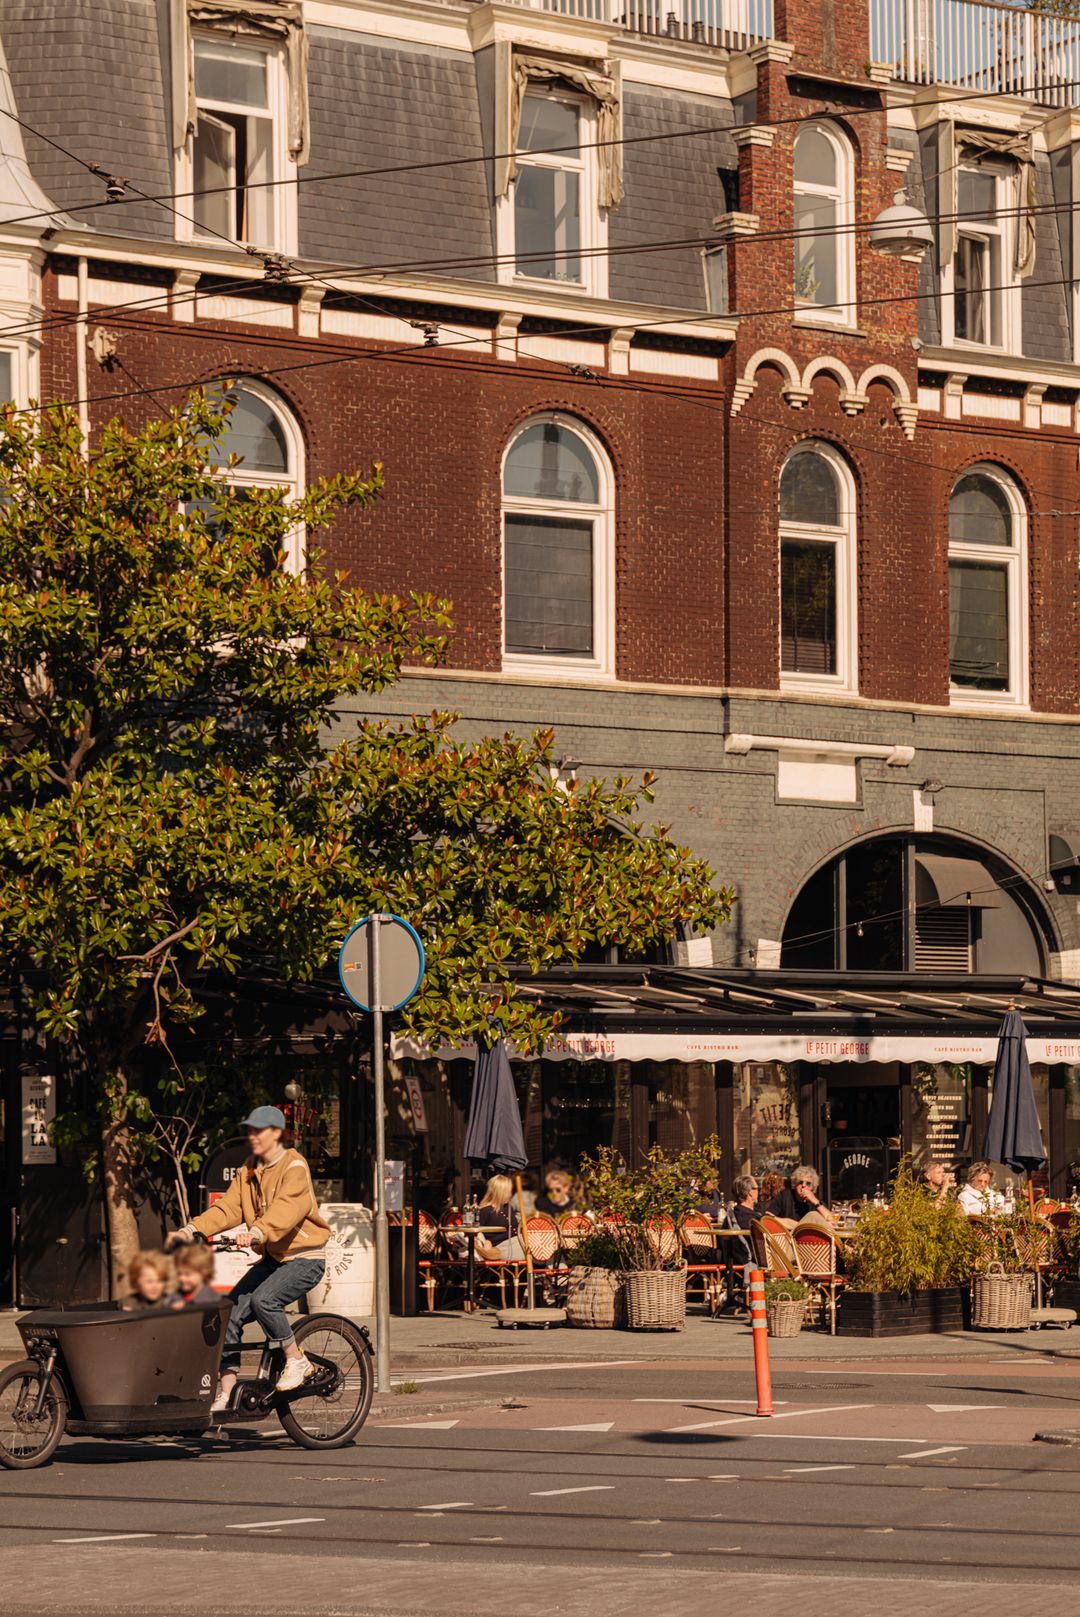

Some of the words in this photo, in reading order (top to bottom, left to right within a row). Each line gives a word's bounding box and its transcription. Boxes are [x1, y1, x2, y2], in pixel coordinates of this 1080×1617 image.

[556, 1040, 580, 1053] PETIT
[583, 1040, 616, 1053] GEORGE
[815, 1042, 837, 1055] PETIT
[840, 1042, 870, 1055] GEORGE
[1054, 1045, 1075, 1057] PETIT
[31, 1123, 46, 1134] LA
[31, 1135, 46, 1146] LA
[843, 1153, 870, 1168] GEORGE
